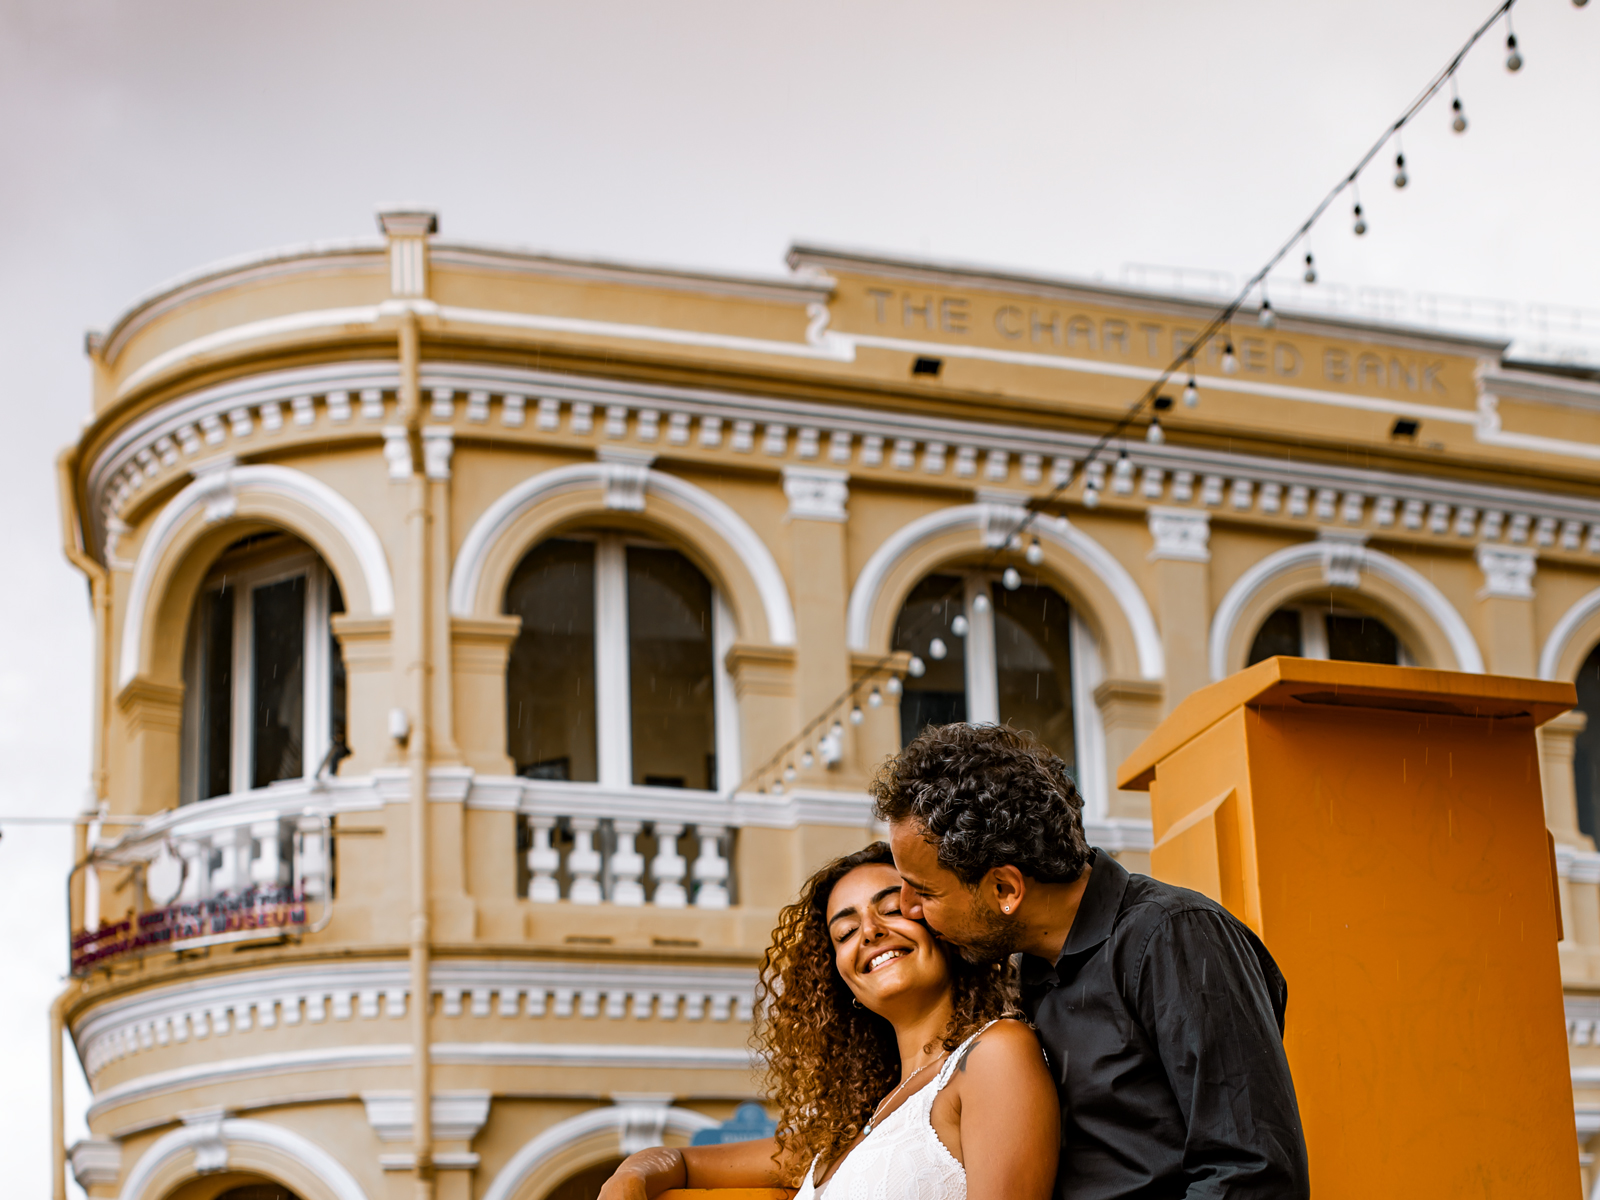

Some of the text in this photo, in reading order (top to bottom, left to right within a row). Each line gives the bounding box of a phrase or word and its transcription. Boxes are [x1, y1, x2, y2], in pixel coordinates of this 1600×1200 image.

[865, 286, 971, 335] THE
[1324, 347, 1447, 395] BANK
[211, 908, 306, 933] MUSEUM
